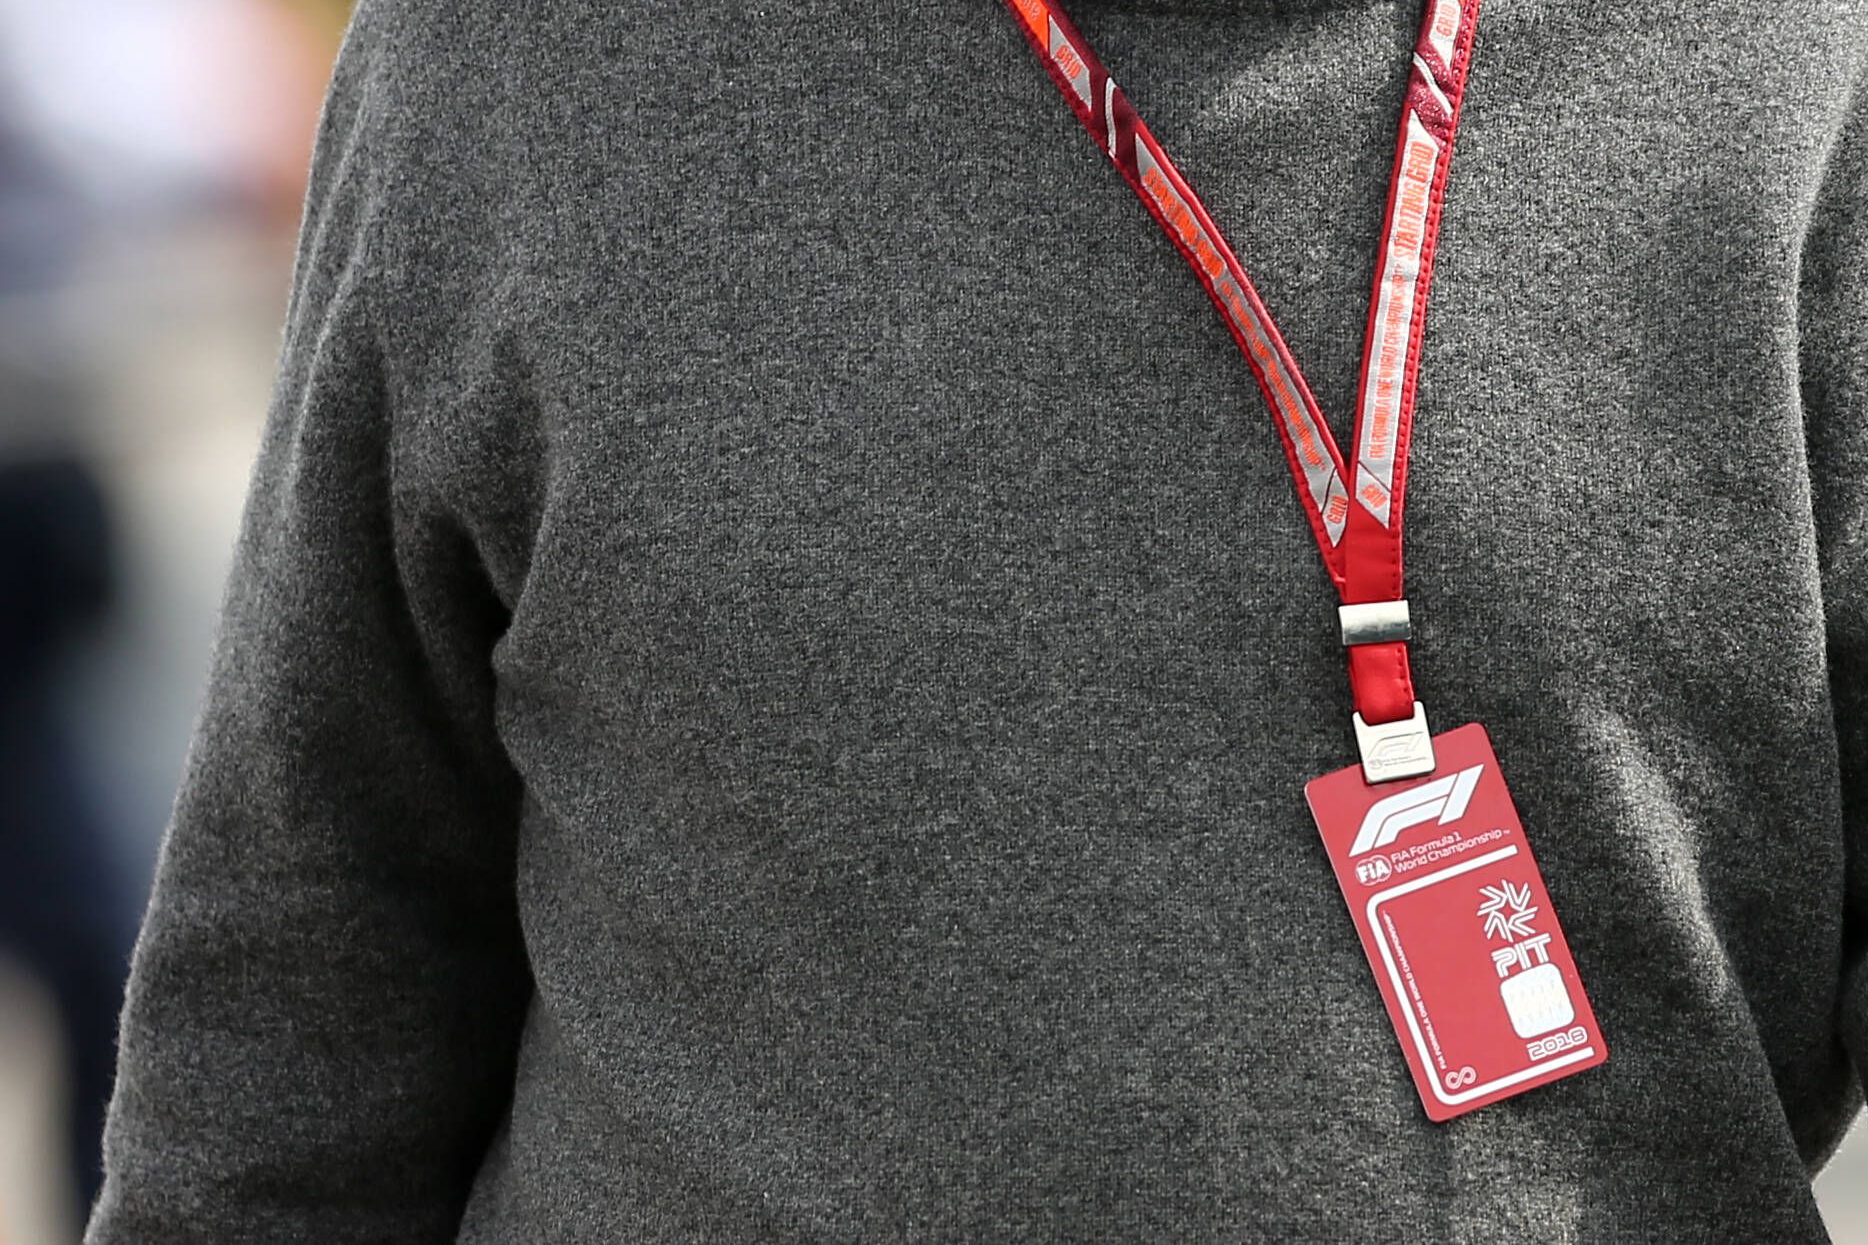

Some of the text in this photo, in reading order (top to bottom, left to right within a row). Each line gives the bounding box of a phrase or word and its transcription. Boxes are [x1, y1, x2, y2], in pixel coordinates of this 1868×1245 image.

[1436, 4, 1457, 37] GRID
[1394, 141, 1434, 261] STARTING GRID
[1390, 832, 1462, 864] FIA Formula 1
[1393, 829, 1502, 874] World Championship
[1356, 859, 1390, 884] FIA
[1491, 933, 1551, 978] PIT
[1417, 1000, 1427, 1018] ONE
[1423, 1018, 1442, 1056] FORMULA
[1526, 1025, 1588, 1061] 2018
[1437, 1054, 1447, 1070] FIA
